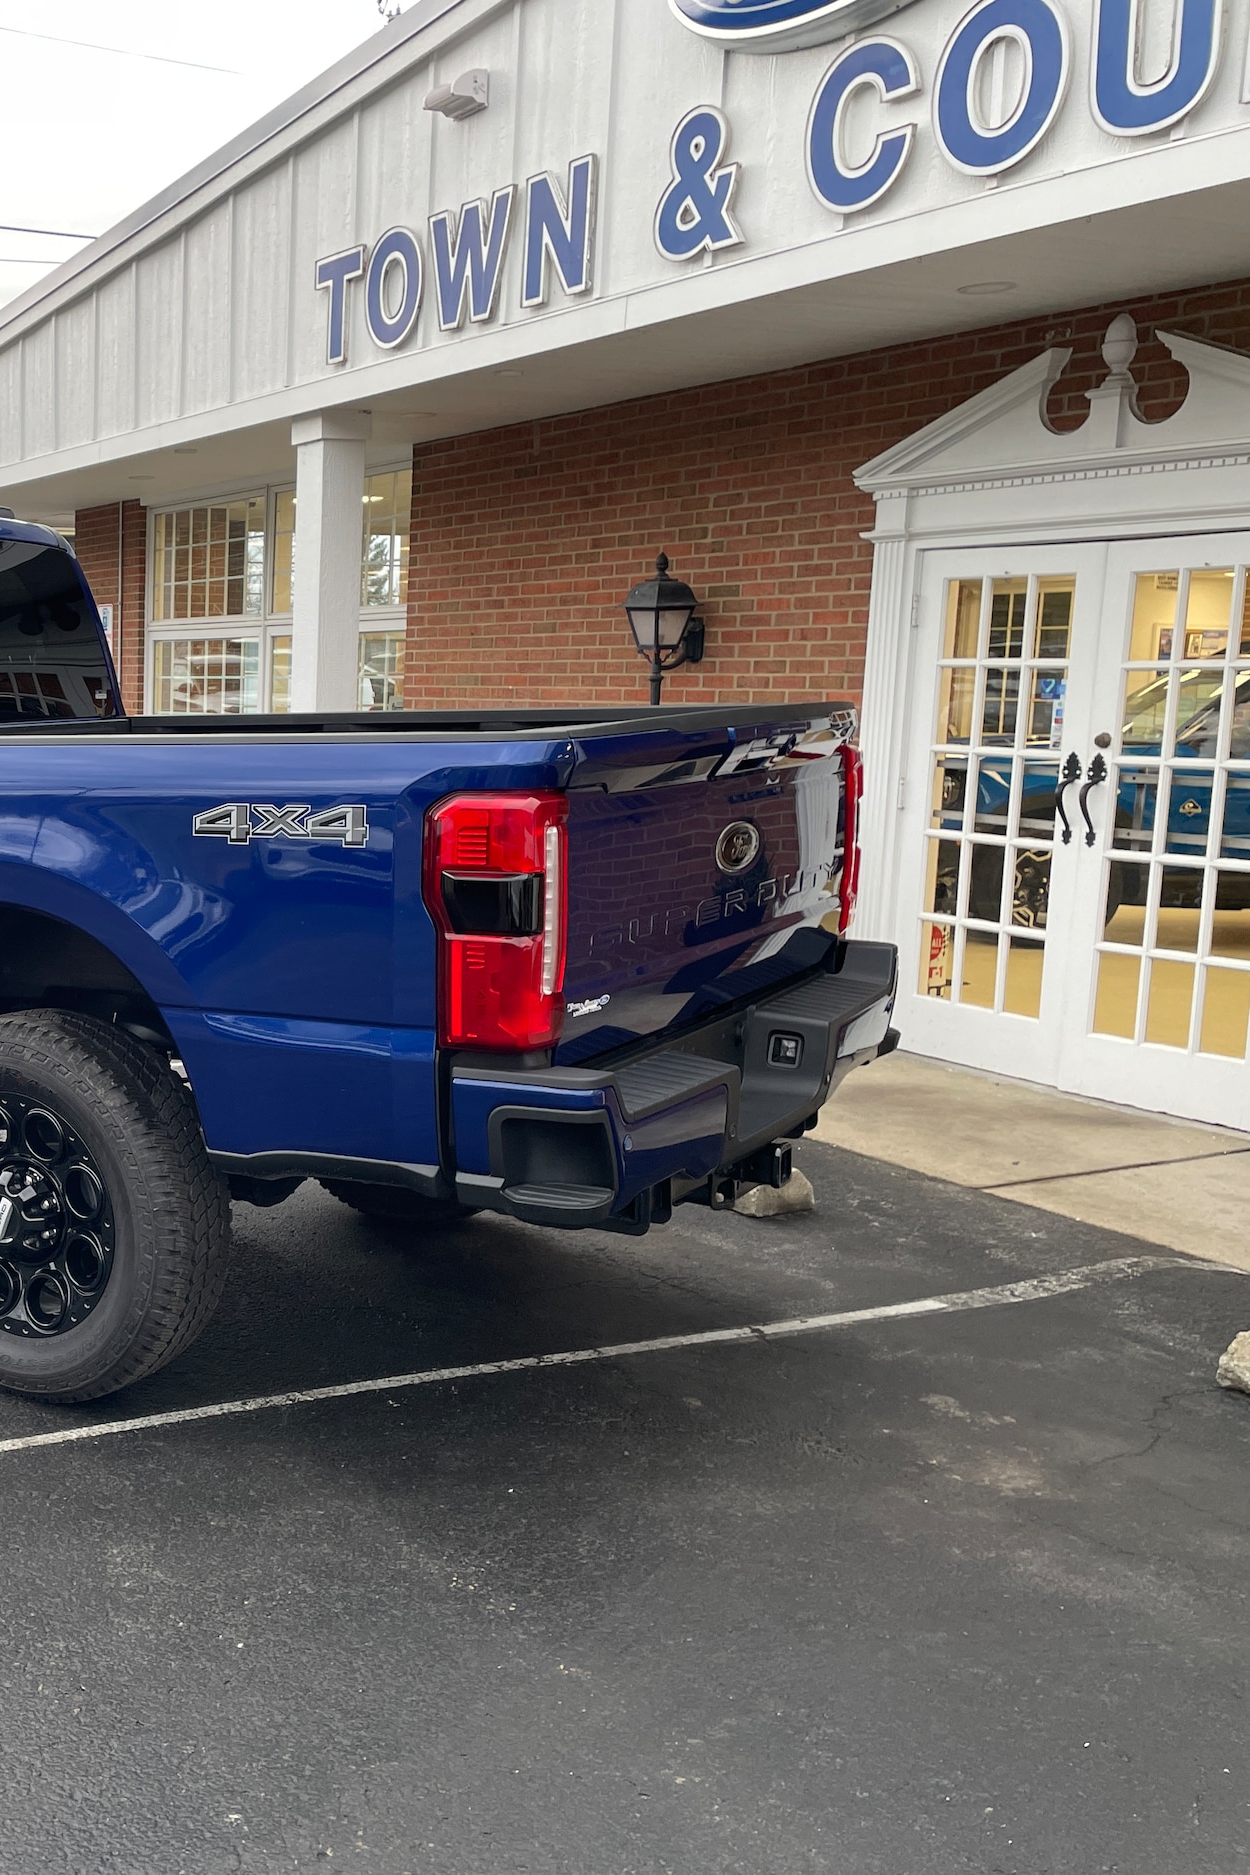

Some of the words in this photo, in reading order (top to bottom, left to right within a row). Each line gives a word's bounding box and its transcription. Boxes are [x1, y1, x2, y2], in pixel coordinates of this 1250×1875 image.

[315, 153, 597, 366] TOWN
[654, 104, 745, 263] &
[804, 0, 1250, 214] COU
[589, 888, 747, 957] SUPER
[756, 857, 840, 908] DUTY
